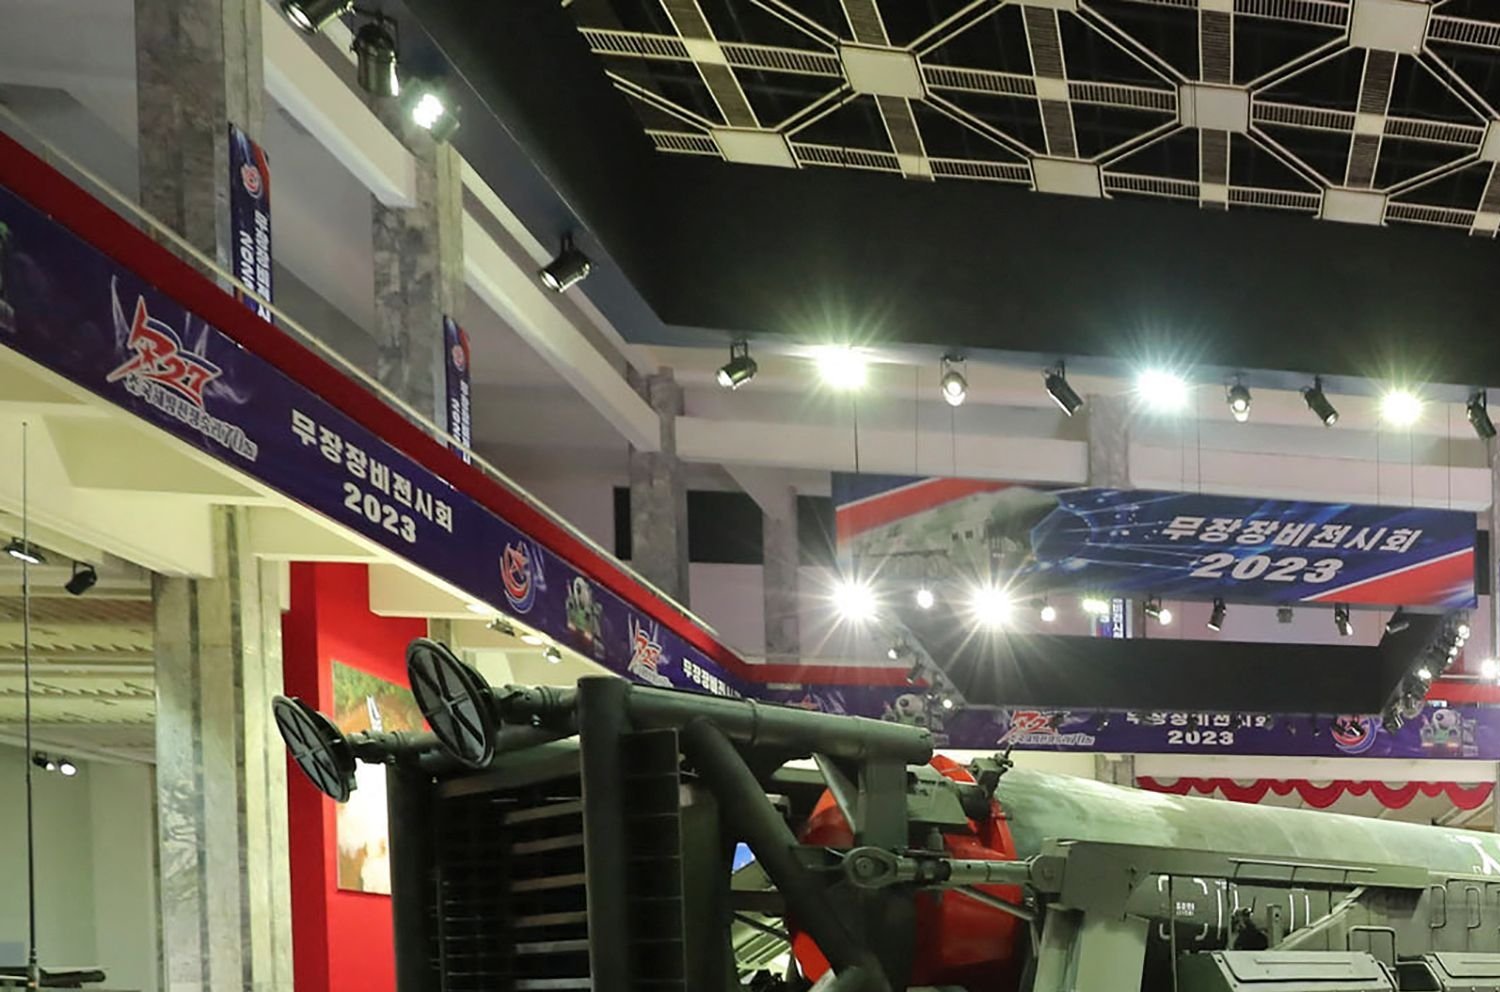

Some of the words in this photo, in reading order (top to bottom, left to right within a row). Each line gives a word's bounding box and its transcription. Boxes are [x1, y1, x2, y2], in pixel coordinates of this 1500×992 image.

[291, 409, 453, 533] 무장장비전시회
[343, 483, 417, 543] 2023
[1161, 515, 1422, 553] 무장장비전시회
[1190, 553, 1344, 583] 2023
[683, 657, 741, 698] 무장장비전
[1168, 730, 1234, 745] 2023
